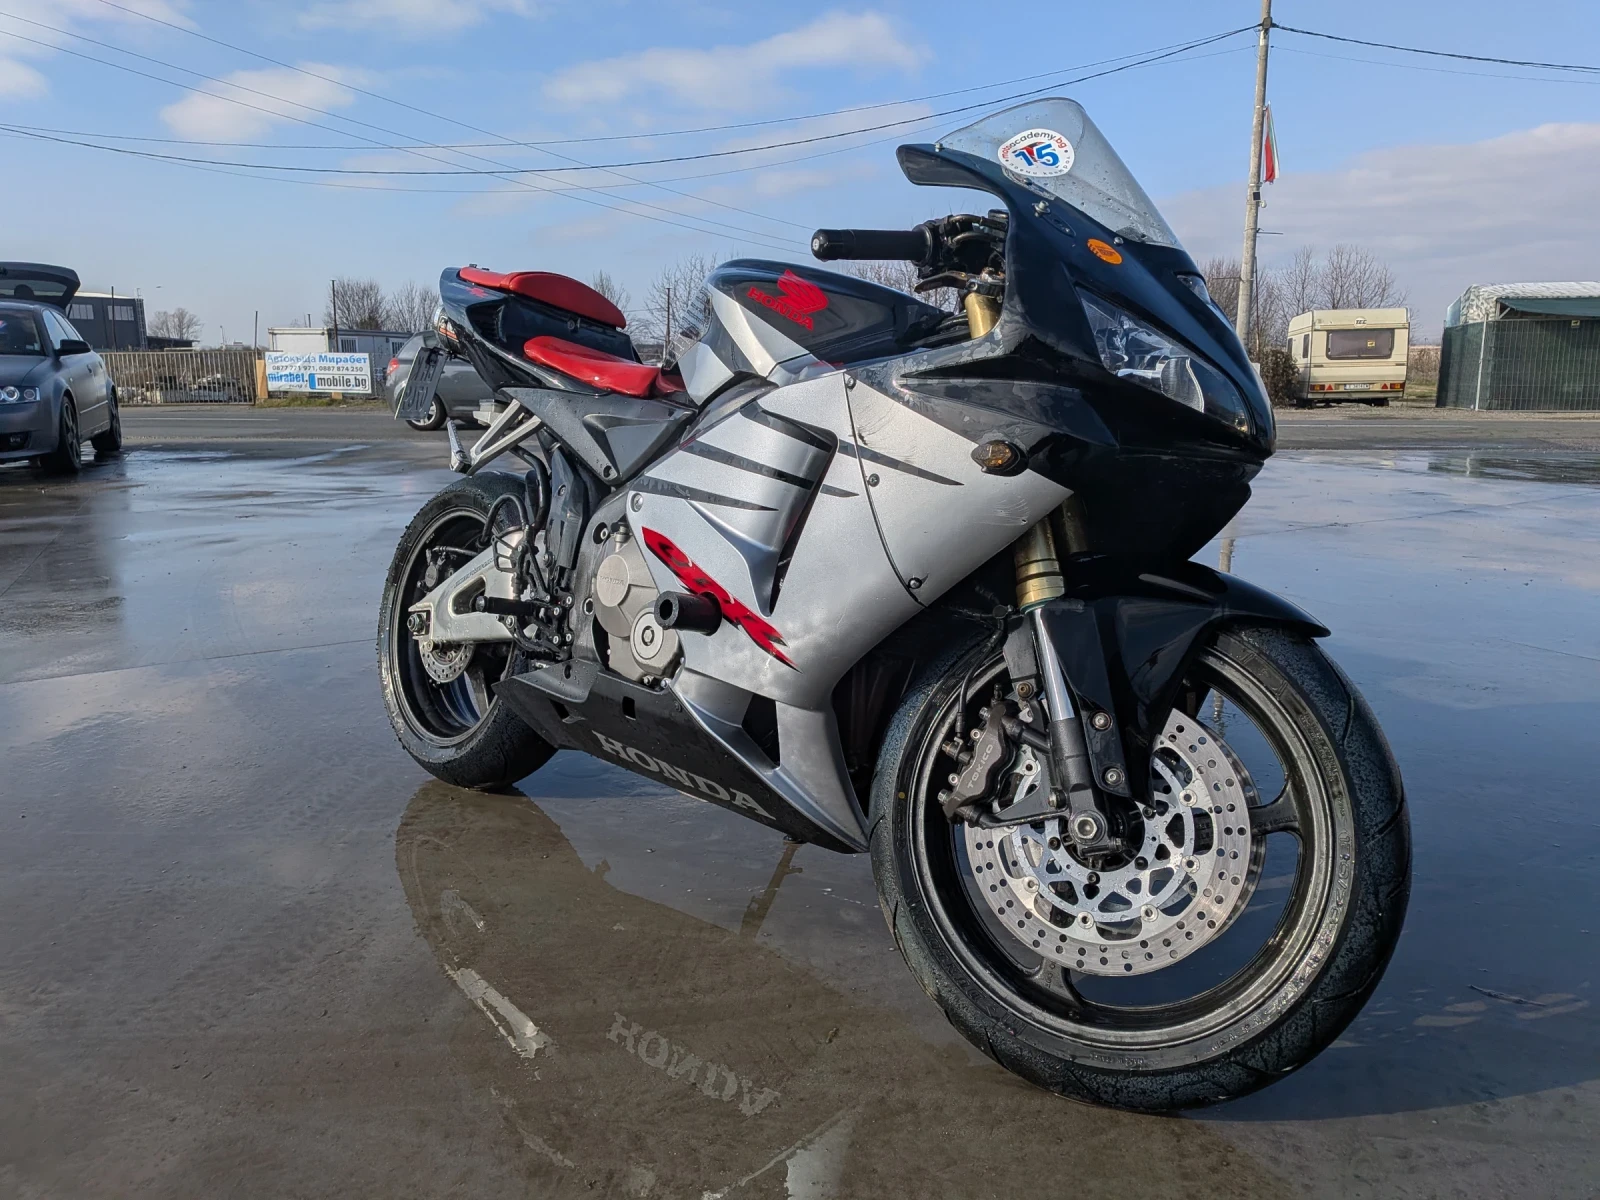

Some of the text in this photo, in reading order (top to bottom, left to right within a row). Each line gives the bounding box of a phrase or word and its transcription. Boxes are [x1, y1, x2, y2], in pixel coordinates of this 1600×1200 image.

[1002, 132, 1067, 158] motoacademy.bg
[1014, 143, 1060, 167] 15
[746, 286, 814, 331] HONDA
[318, 354, 368, 365] Мирабет
[317, 375, 367, 389] mobile.bg
[591, 729, 777, 821] HONDA
[967, 744, 994, 788] TOKICO
